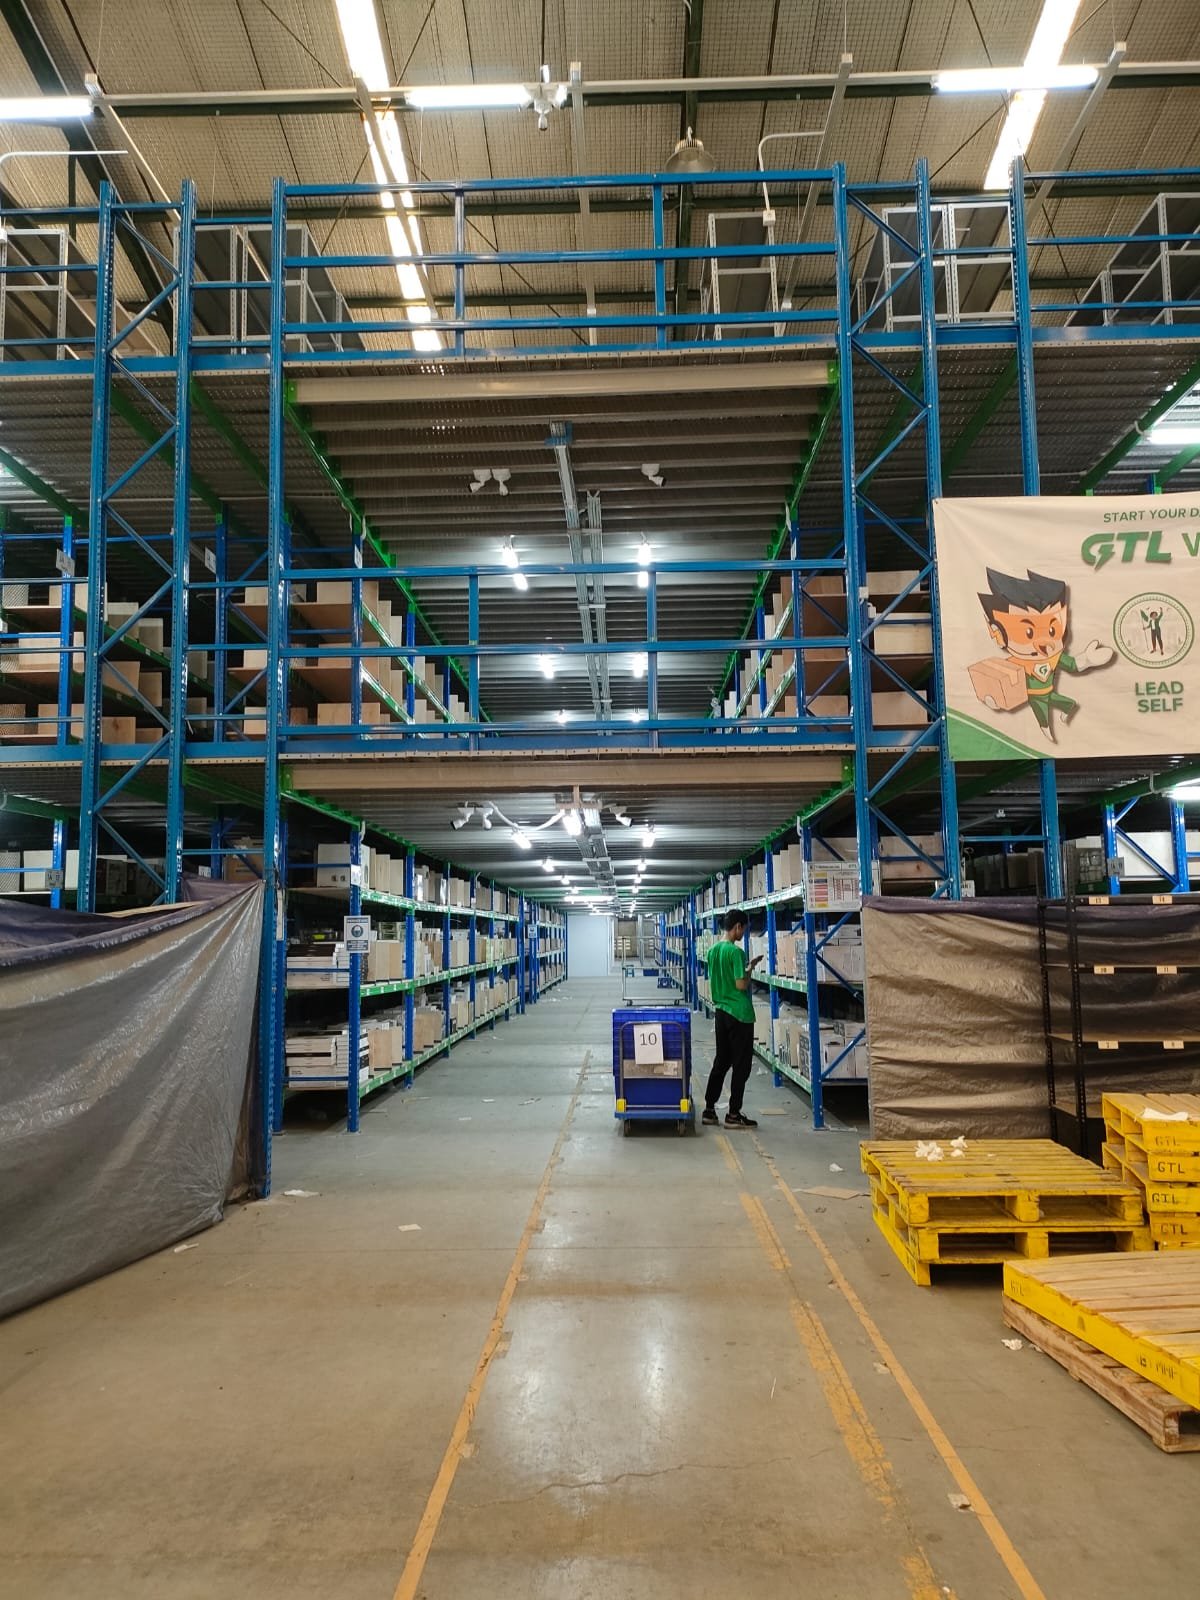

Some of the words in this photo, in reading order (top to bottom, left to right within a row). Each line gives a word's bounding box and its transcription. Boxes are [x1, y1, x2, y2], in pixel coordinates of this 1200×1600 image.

[1103, 510, 1146, 523] START
[1149, 508, 1186, 519] YOUR
[1190, 507, 1200, 518] D
[1081, 530, 1172, 573] GTL
[1135, 680, 1184, 696] LEAD
[1137, 697, 1183, 713] SELF
[640, 1032, 657, 1046] 10
[1155, 1135, 1180, 1146] GTL
[1157, 1161, 1185, 1174] GTL
[1152, 1193, 1178, 1205] GTL
[1160, 1223, 1188, 1235] GTL
